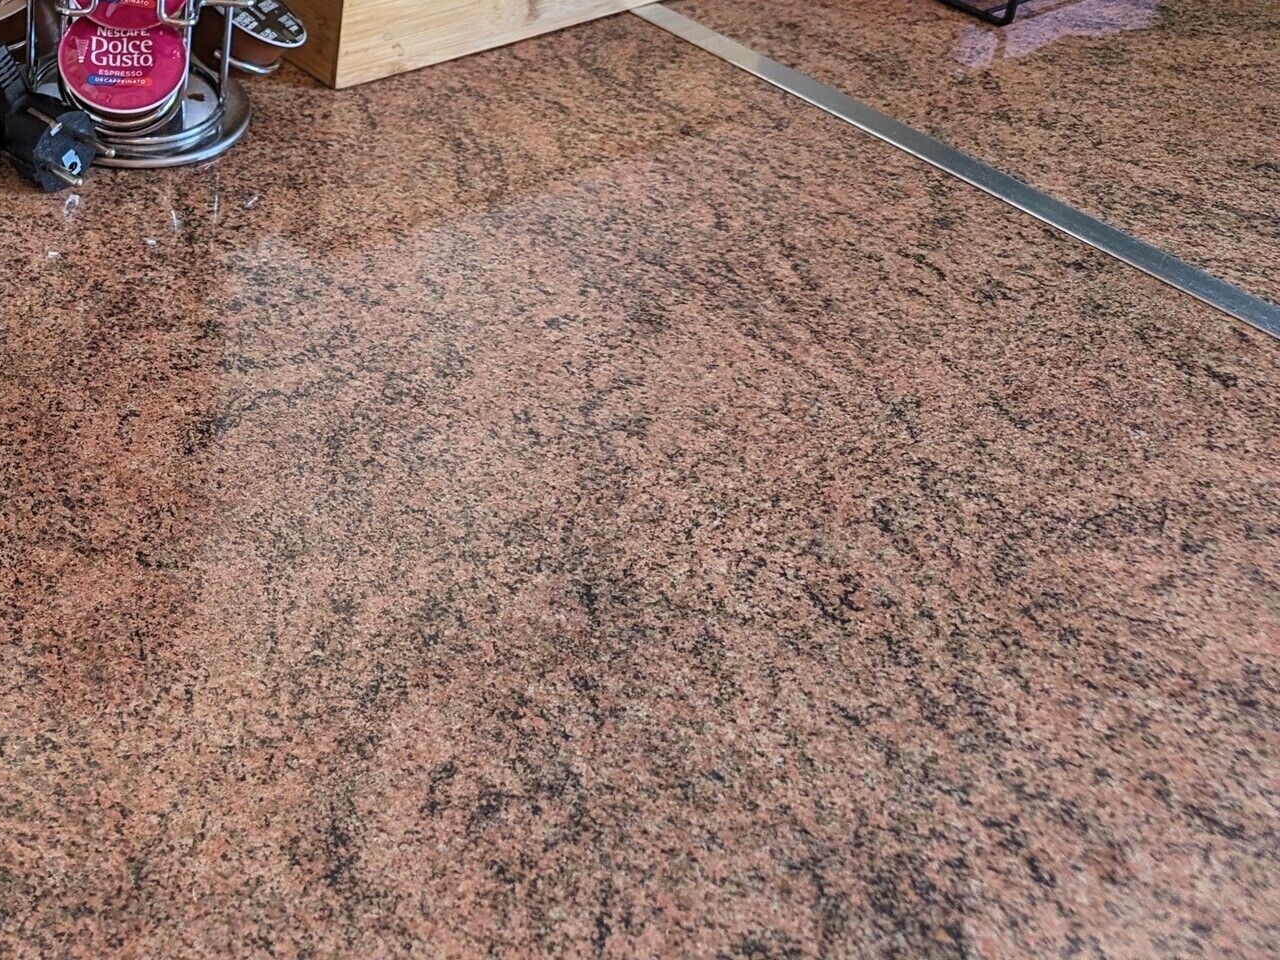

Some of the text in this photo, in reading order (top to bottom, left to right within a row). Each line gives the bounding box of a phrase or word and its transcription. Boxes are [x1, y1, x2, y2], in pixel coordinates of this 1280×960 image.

[91, 36, 153, 54] Dolce
[90, 51, 153, 67] Gusto
[98, 69, 143, 77] ESPRESSO
